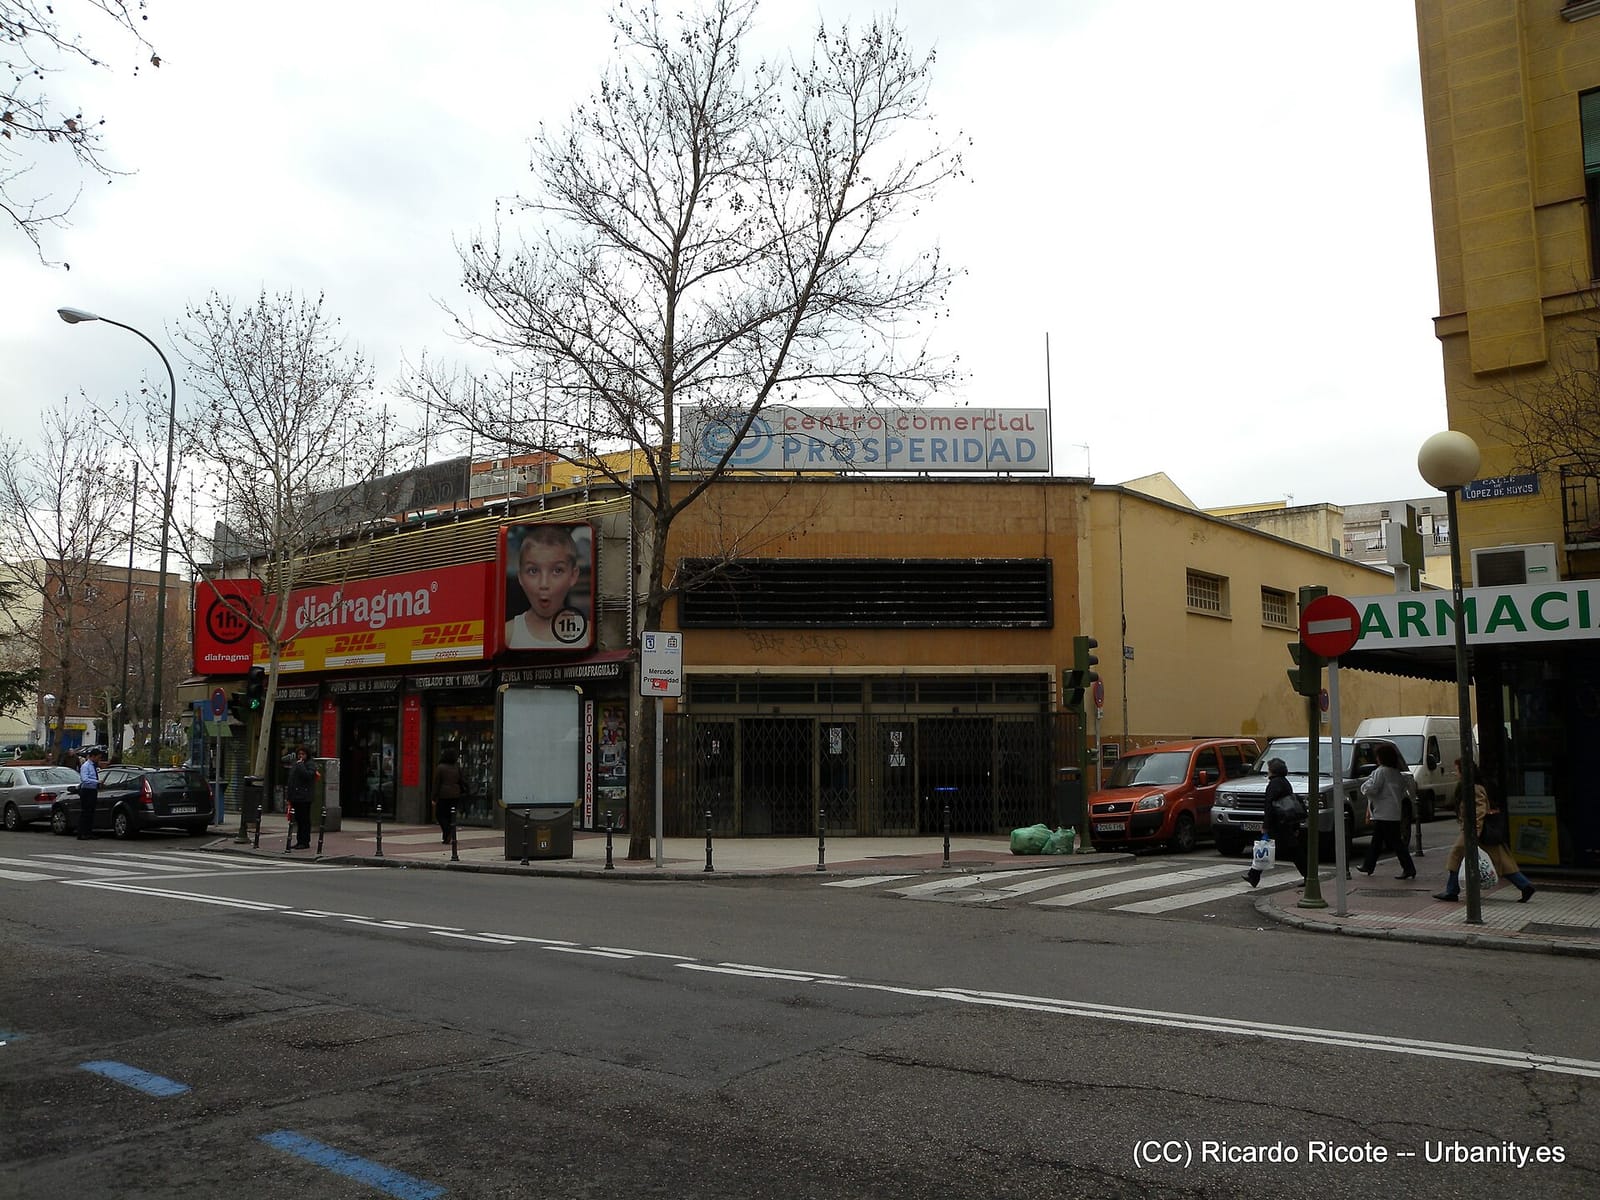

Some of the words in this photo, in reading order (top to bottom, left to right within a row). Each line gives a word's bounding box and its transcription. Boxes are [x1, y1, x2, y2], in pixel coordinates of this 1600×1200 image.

[783, 412, 883, 432] centro
[896, 411, 1036, 432] comercial
[784, 437, 1038, 464] PROSPERIDAD
[1466, 488, 1492, 499] LOPEZ
[1358, 589, 1600, 640] ARMACI
[334, 633, 377, 652] DHL
[422, 623, 474, 645] DHL
[445, 676, 454, 686] EN
[462, 674, 480, 686] HORA
[535, 669, 552, 680] FOTOS
[554, 669, 562, 679] EN
[648, 667, 675, 675] Mercado
[585, 703, 593, 754] FOTOS
[585, 762, 593, 825] CARNET
